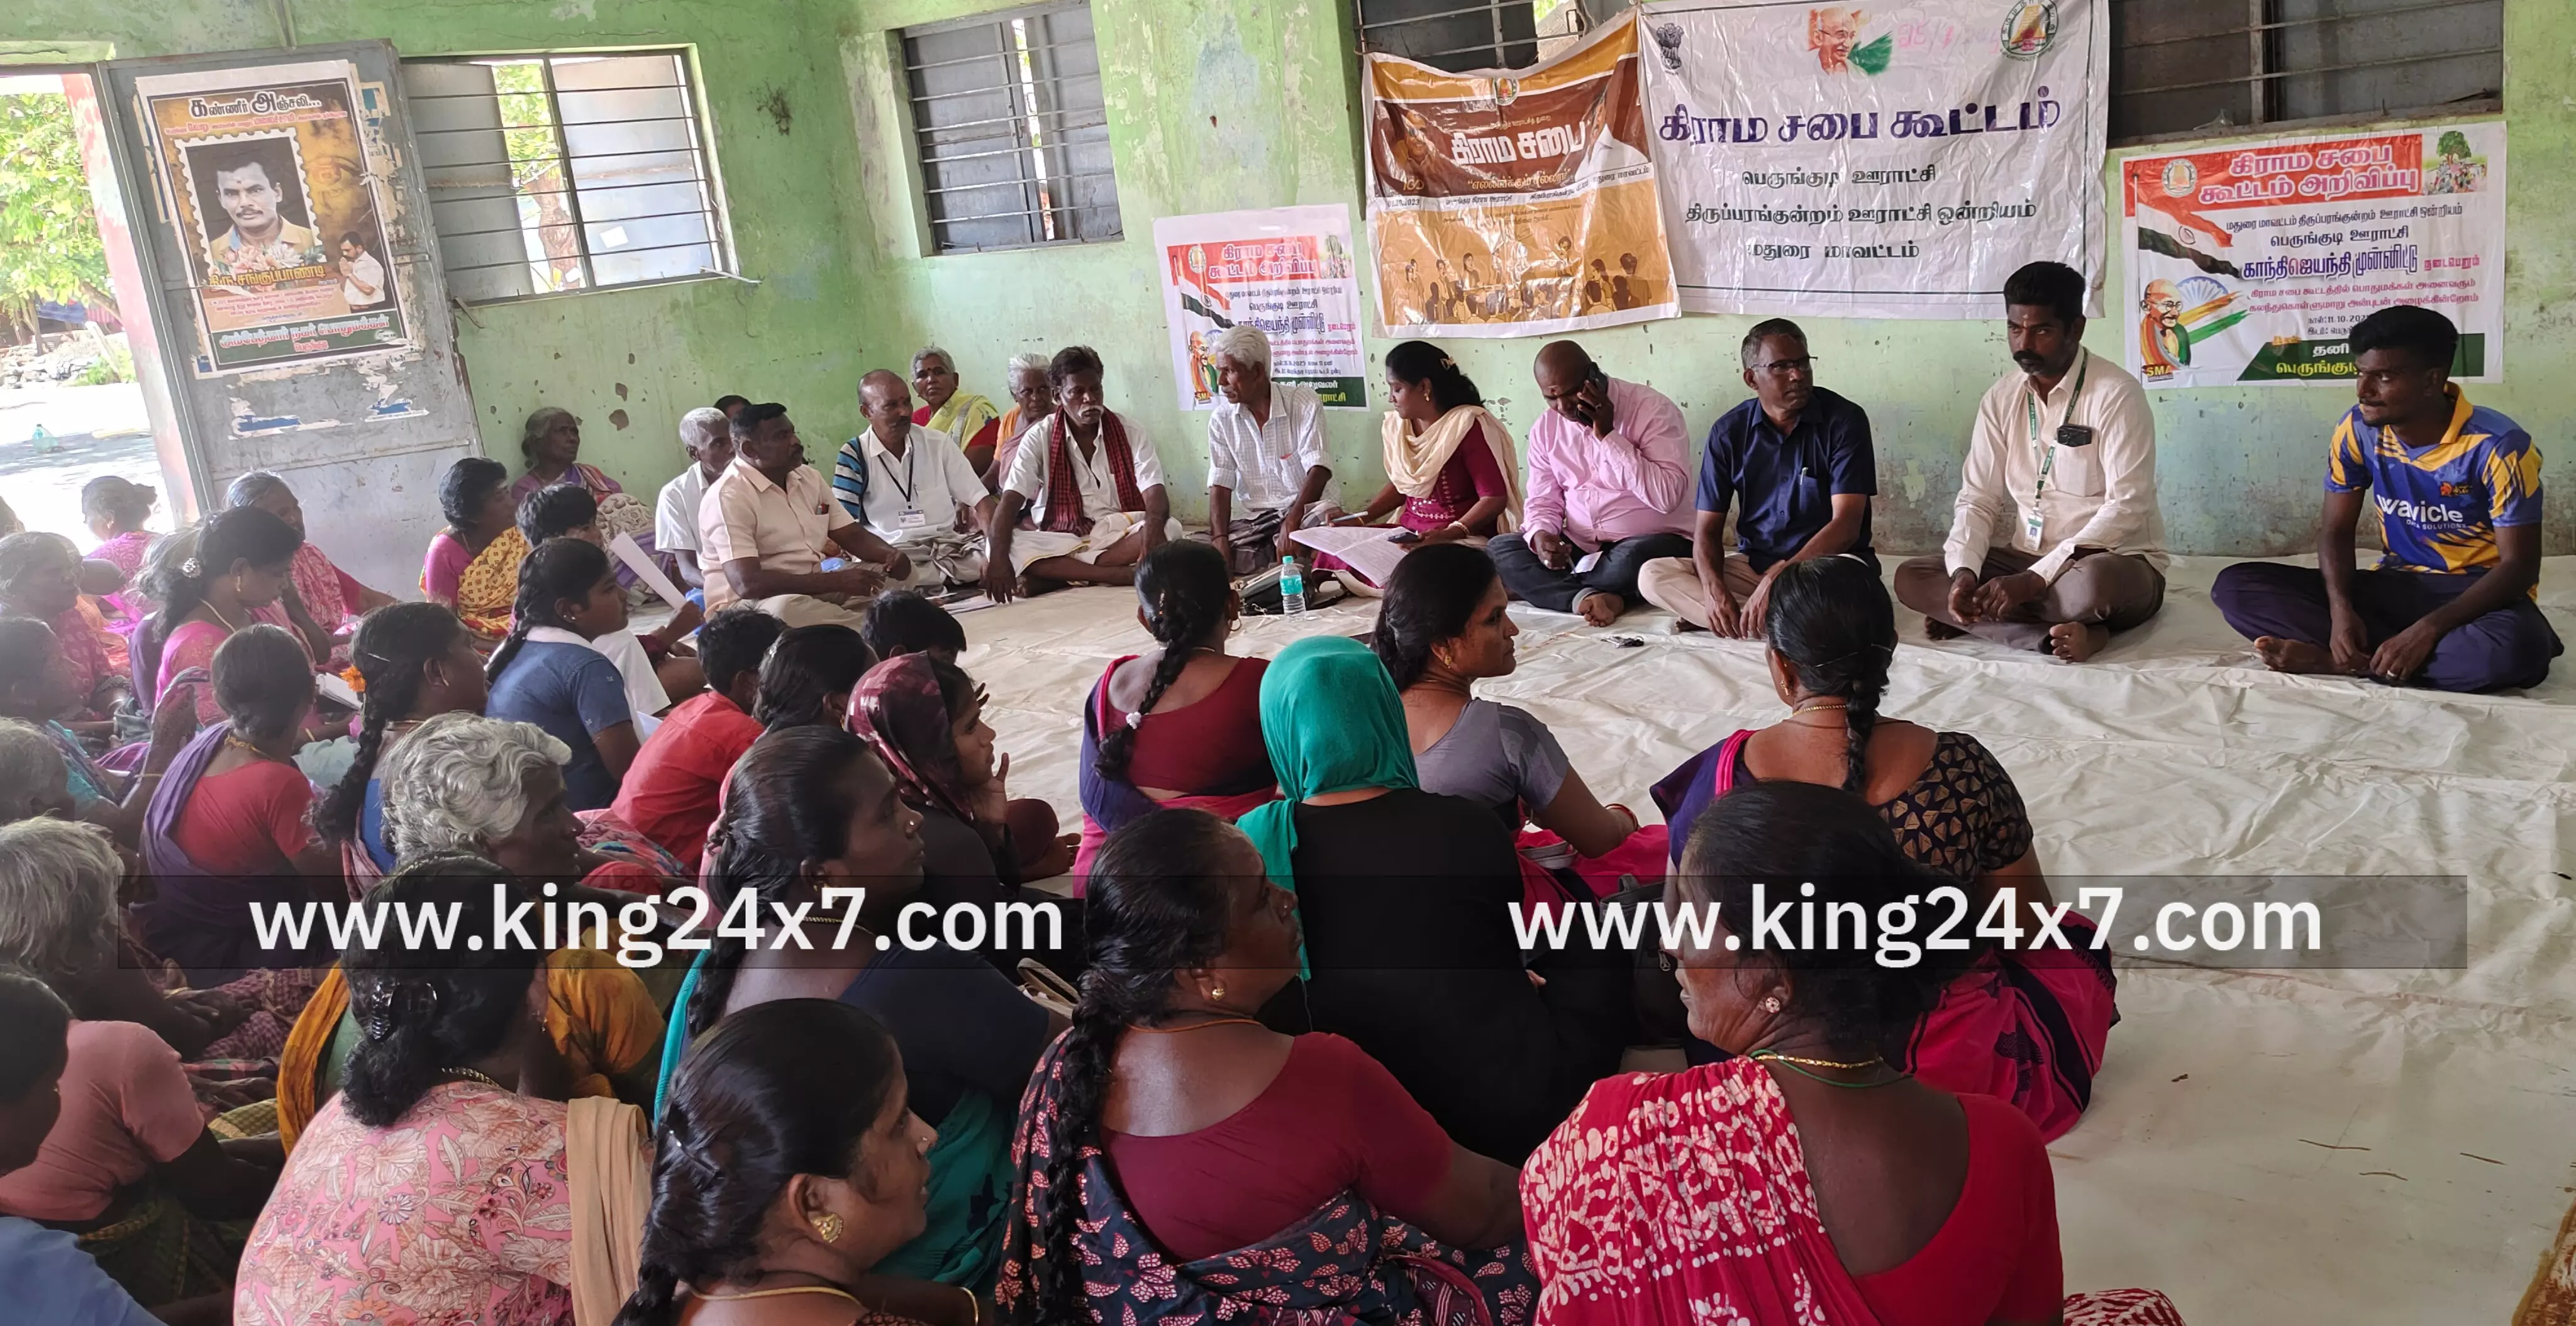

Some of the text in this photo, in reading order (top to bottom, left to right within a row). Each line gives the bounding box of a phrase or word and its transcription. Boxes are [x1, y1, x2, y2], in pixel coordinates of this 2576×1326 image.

[191, 97, 248, 118] கண்ணீர்
[1658, 86, 2061, 146] கிராம சபை கூட்டம்
[1451, 121, 1585, 166] கிராம சபை
[2230, 148, 2311, 176] கிராம
[2317, 145, 2392, 171] சபை
[1742, 164, 1936, 188] பெருங்குடி ஊராட்சி
[2199, 175, 2294, 204] கூட்டம்
[2300, 165, 2418, 201] அறிவிப்பு
[1685, 199, 2036, 225] திருப்பரங்குன்றம் ஊராட்சி ஒன்றியம்
[2226, 203, 2463, 232] மதுரை மாவட்டம் திருப்பரங்குன்றம் ஊராட்சி ஒன்றியம்
[2270, 226, 2409, 247] பெருங்குடி ஊராட்சி
[1223, 244, 1262, 260] கிராம
[1748, 240, 1919, 260] மதுரை மாவட்டம்
[2243, 244, 2480, 282] காந்திஜெயந்தி முன்னிட்டு நடைபெறும்
[2251, 278, 2476, 299] கிராம சபை கூட்டத்தில் பொதுமக்கள் அனைவரும்
[2347, 296, 2392, 309] அன்புடன்
[2393, 293, 2479, 307] அழைக்கின்றோம்
[2307, 314, 2368, 324] நாள்:11.10.202
[2312, 343, 2350, 357] தனி
[1320, 392, 1346, 402] ராட்சி
[2377, 494, 2463, 523] wavicle
[2423, 522, 2466, 531] SOLUTIONS
